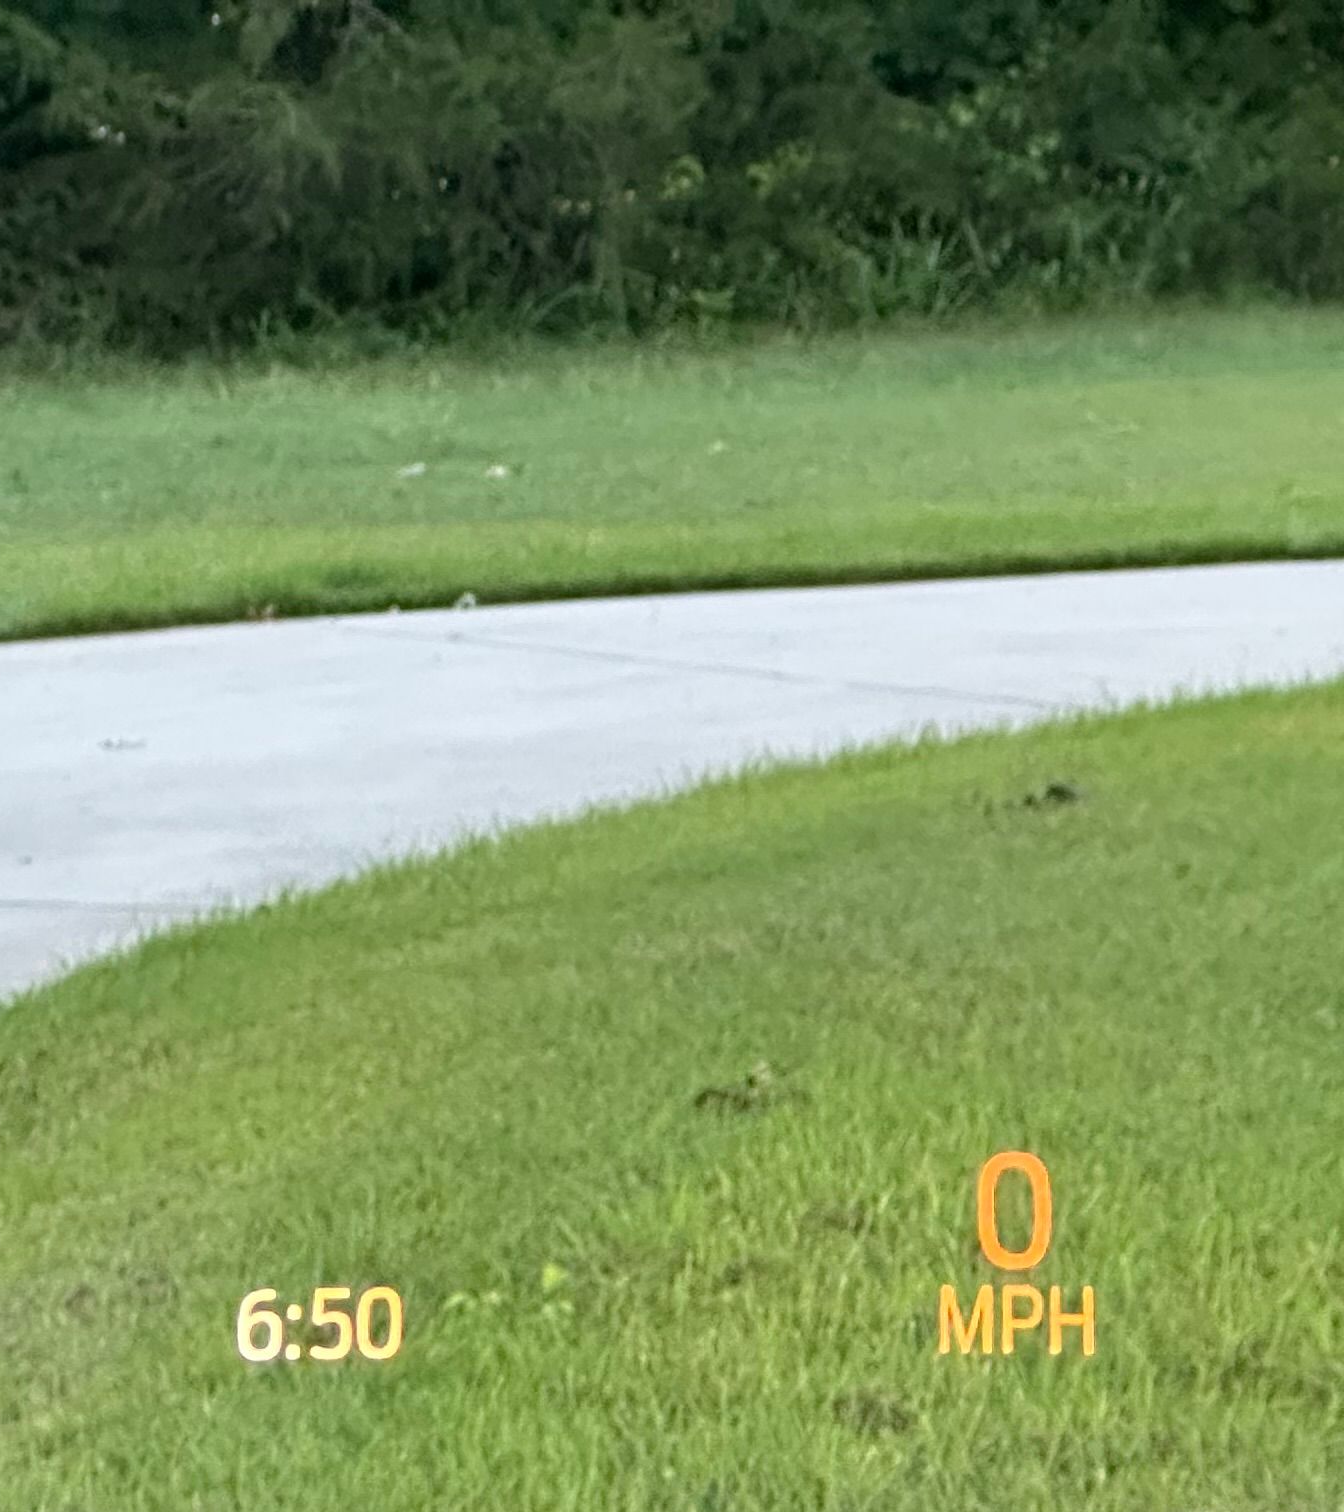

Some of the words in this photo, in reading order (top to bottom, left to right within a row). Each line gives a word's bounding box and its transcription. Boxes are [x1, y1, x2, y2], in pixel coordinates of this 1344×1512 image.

[977, 1151, 1052, 1270] 0
[237, 1286, 403, 1361] 6:50
[939, 1284, 1095, 1356] MPH
